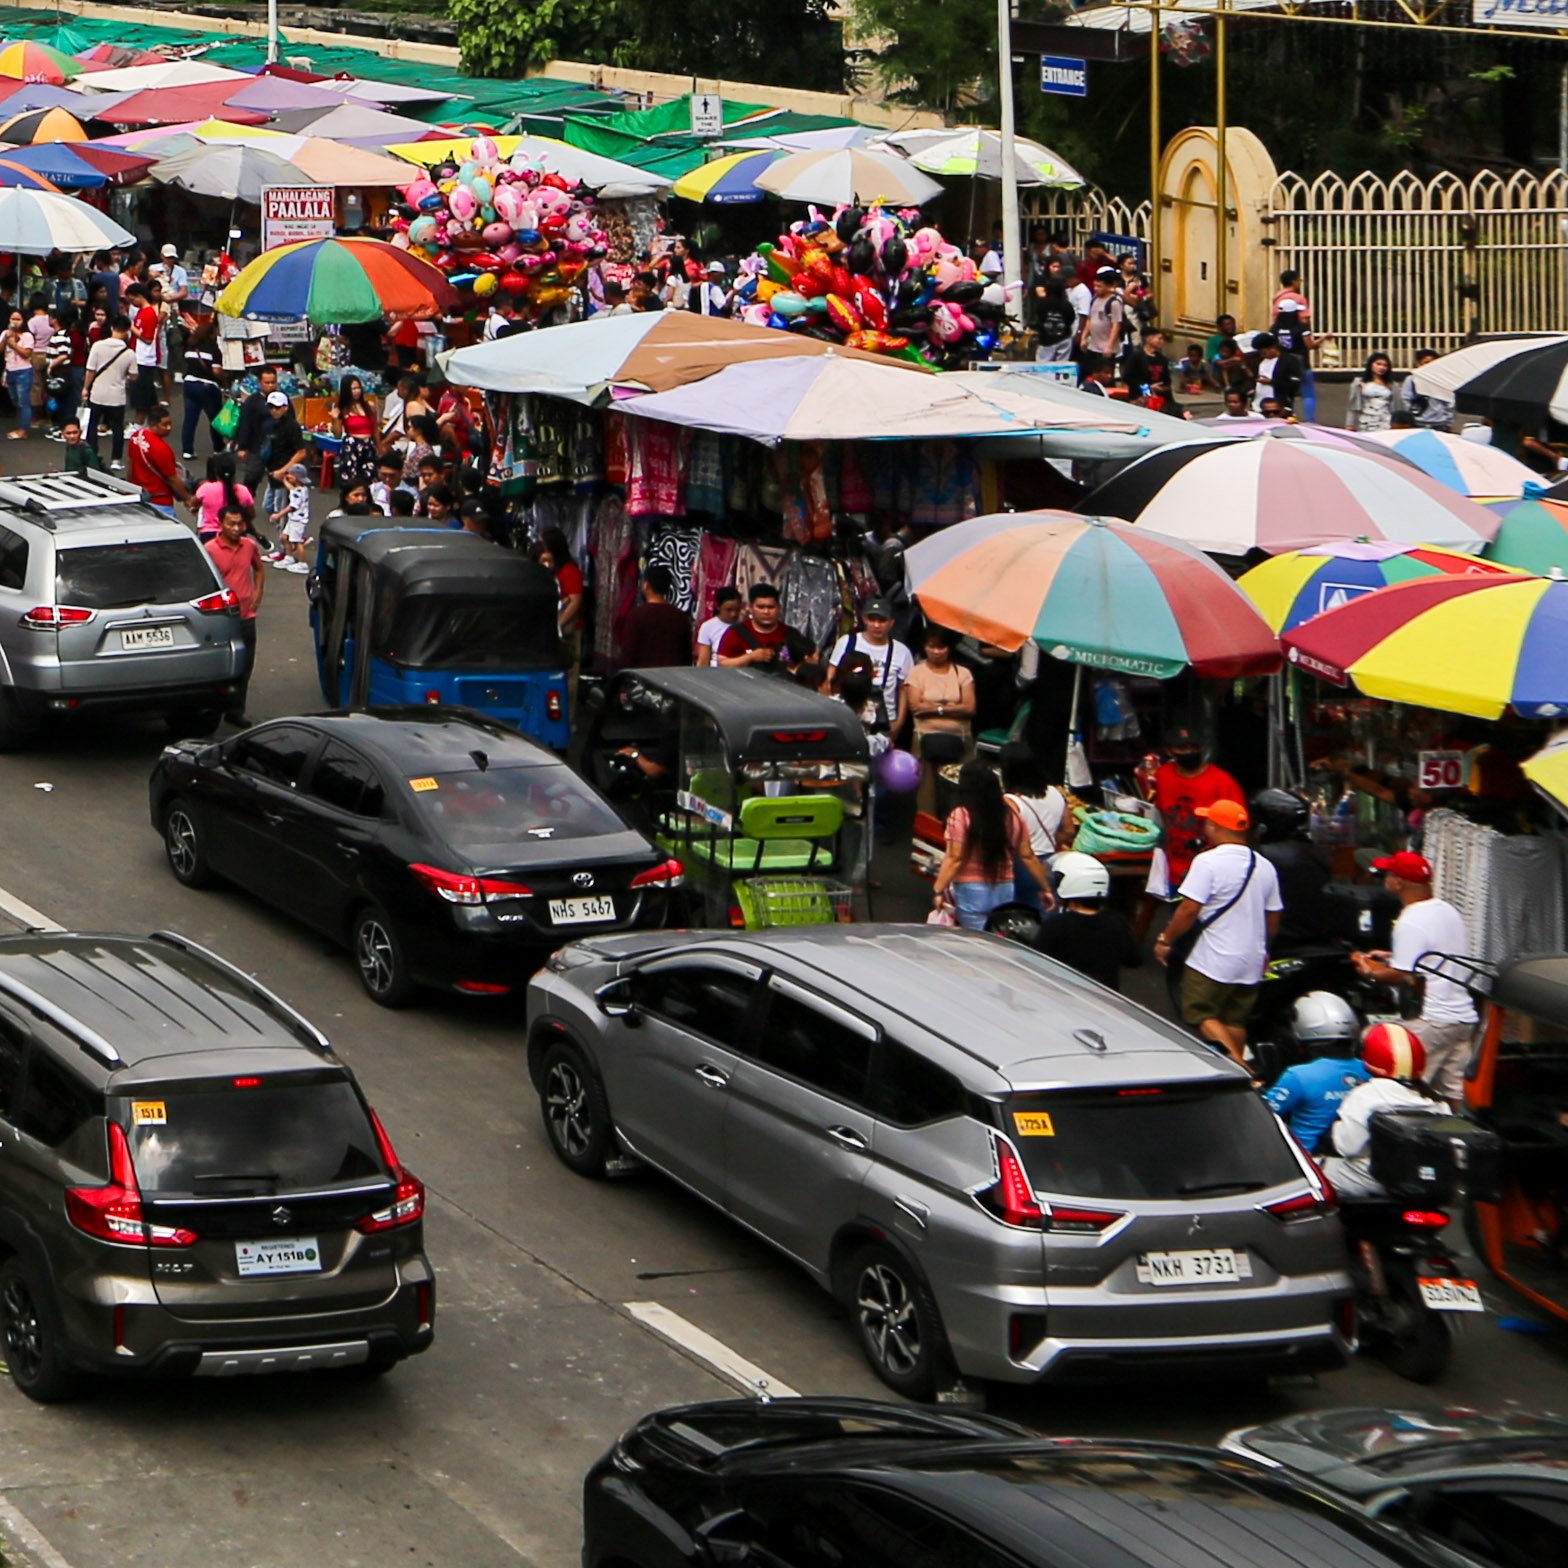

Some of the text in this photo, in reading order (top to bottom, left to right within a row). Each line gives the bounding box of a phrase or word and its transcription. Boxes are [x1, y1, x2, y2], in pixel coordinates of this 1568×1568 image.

[1042, 67, 1085, 87] ENTRANCE
[268, 191, 330, 202] MAHALAGANG
[268, 203, 330, 218] PAALALA
[1422, 760, 1460, 786] 50
[552, 901, 611, 919] NHS 5467
[256, 1250, 305, 1264] AY 151B
[1152, 1256, 1234, 1277] NKH 3731
